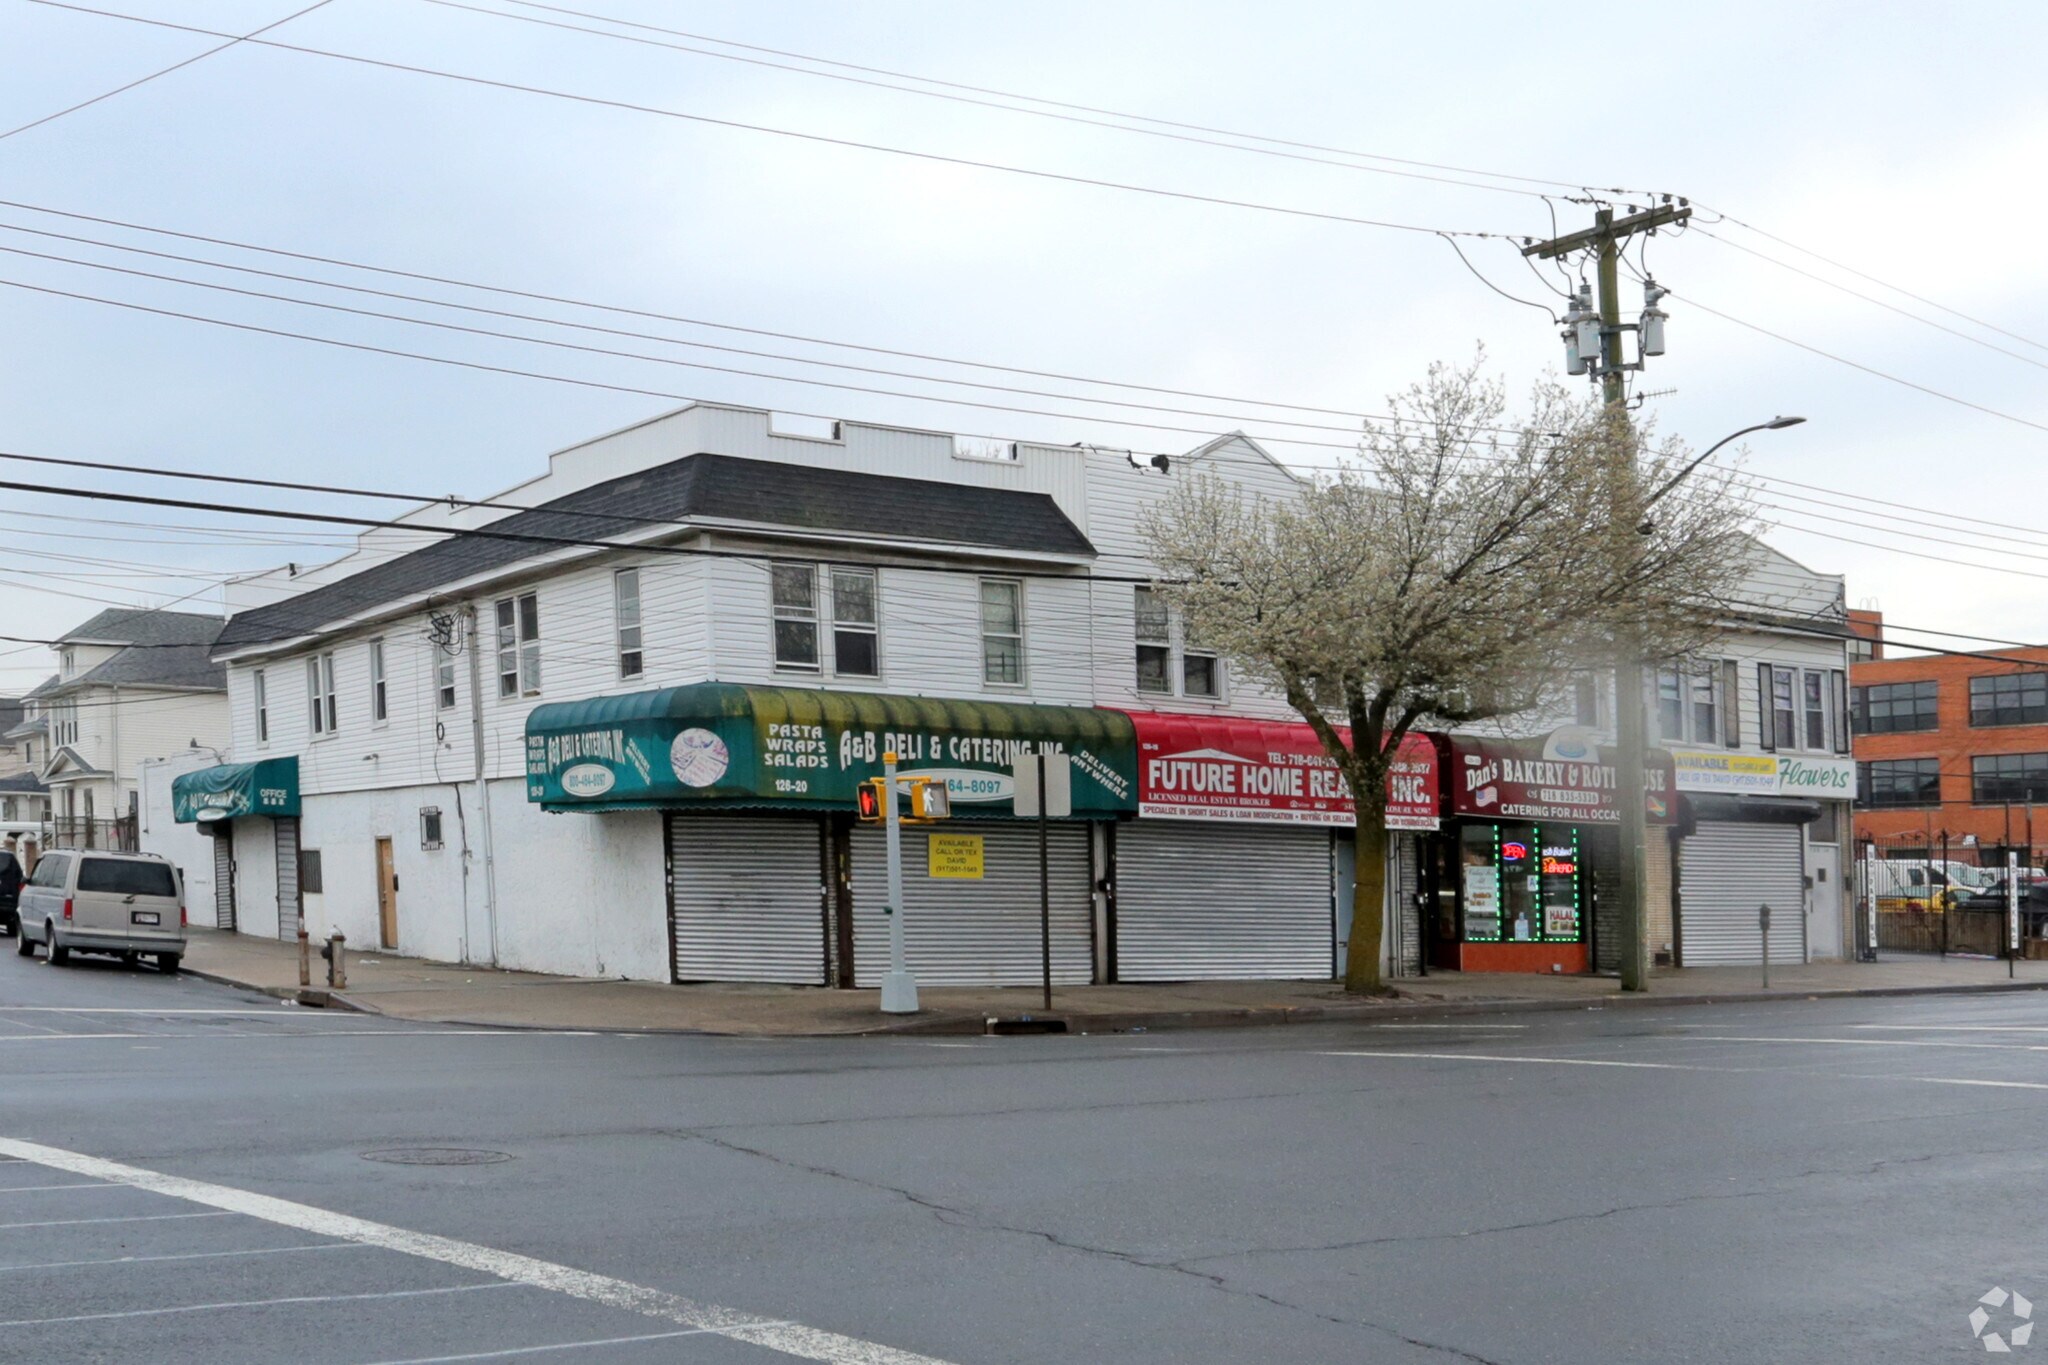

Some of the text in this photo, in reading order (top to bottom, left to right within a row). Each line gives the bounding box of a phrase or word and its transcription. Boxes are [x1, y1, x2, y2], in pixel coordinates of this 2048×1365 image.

[769, 723, 822, 739] PASTA
[766, 738, 827, 753] WRAPS
[840, 730, 876, 771] A&B
[884, 732, 922, 760] DELI
[930, 736, 941, 760] &
[949, 737, 1032, 767] CATERING
[764, 753, 829, 768] SALADS
[1267, 752, 1286, 765] TEL:
[1677, 756, 1729, 770] AVAILABLE
[1080, 750, 1129, 788] DELIVERY
[1466, 759, 1498, 791] Dan's
[1502, 758, 1564, 786] BAKERY
[1568, 763, 1578, 787] &
[1582, 765, 1616, 789] ROTI
[1779, 758, 1849, 789] Flowers
[1070, 755, 1128, 800] ANYWHERE
[1148, 759, 1431, 804] FUTURE HOME REA INC.
[260, 788, 287, 799] OFFICE
[946, 779, 1001, 793] 64-8097
[1148, 792, 1271, 807] LICENSED REAL ESTATE BROKER
[1143, 806, 1177, 815] SPECIALIZE
[1179, 807, 1186, 815] IN
[1187, 808, 1207, 816] SHORT
[1209, 809, 1228, 817] SALES
[1235, 810, 1252, 818] LOAN
[1501, 803, 1549, 816] CATERING
[1550, 806, 1571, 818] FOR
[1572, 808, 1590, 819] ALL
[1502, 844, 1526, 859] OPEN
[1549, 910, 1576, 920] HALAL
